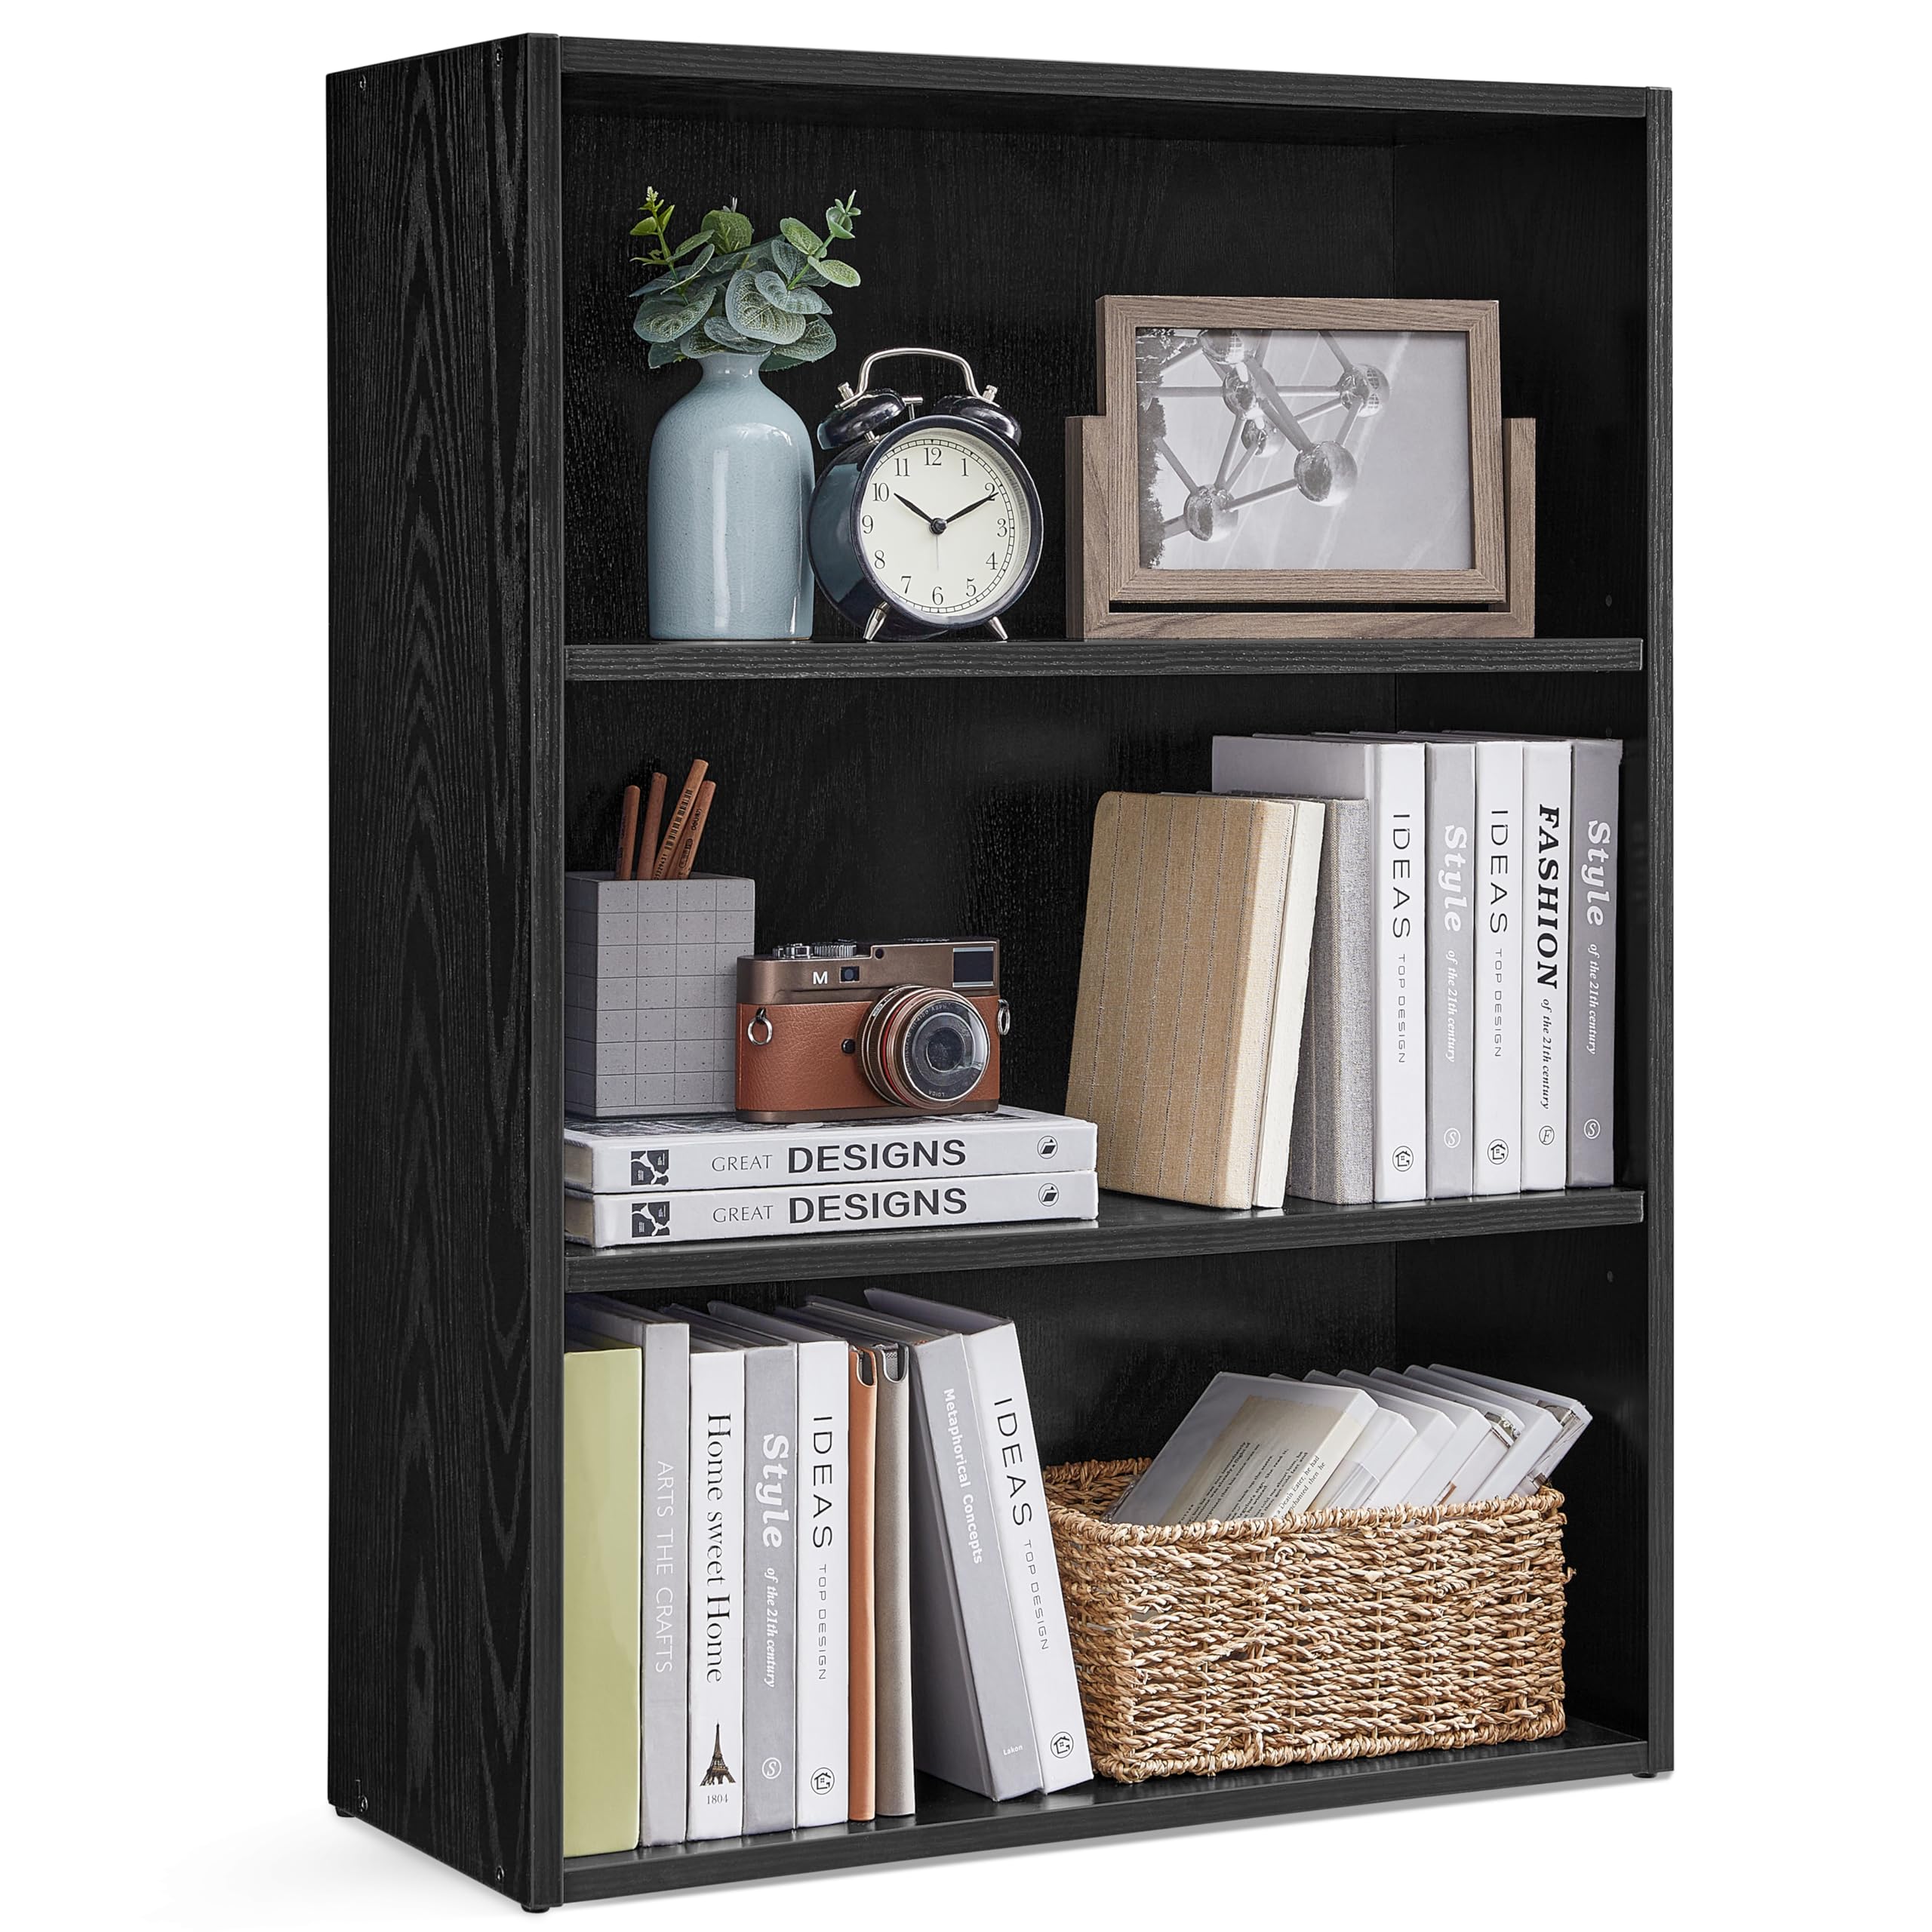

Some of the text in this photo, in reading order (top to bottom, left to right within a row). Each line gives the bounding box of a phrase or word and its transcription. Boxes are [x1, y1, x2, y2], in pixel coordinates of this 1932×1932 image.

[894, 458, 910, 476] 11
[924, 448, 942, 466] 12
[961, 458, 969, 476] 1
[872, 483, 889, 502] 10
[984, 483, 995, 501] 2
[862, 515, 873, 534] 9
[997, 518, 1007, 537] 3
[874, 550, 885, 569] 8
[900, 576, 911, 594] 7
[986, 552, 998, 570] 4
[932, 586, 943, 605] 6
[966, 578, 977, 597] 5
[1393, 814, 1411, 938] IDEAS
[1438, 824, 1468, 932] Style
[1490, 811, 1509, 933] IDEAS
[1537, 804, 1559, 989] FASHION
[1581, 820, 1611, 926] Style
[813, 971, 828, 985] M
[1586, 944, 1600, 1055] of the 21th century
[1445, 949, 1457, 1063] of the 21th century
[1540, 998, 1552, 1109] of the 21th century
[712, 1138, 966, 1174] GREAT DESIGNS
[713, 1188, 968, 1224] GREAT DESIGNS
[813, 1417, 832, 1548] IDEAS
[943, 1388, 983, 1564] Metaphorical Concepts
[994, 1398, 1032, 1526] IDEAS
[1279, 1492, 1294, 1509] Death
[1293, 1477, 1306, 1492] Eater,
[1304, 1467, 1311, 1476] he
[1310, 1456, 1320, 1467] had
[1309, 1472, 1319, 1485] then
[1318, 1462, 1325, 1471] he
[755, 1433, 789, 1548] Style
[655, 1460, 675, 1673] ARTS THE CRAFTS
[706, 1413, 731, 1683] Home sweet Home
[1023, 1540, 1048, 1650] TOP DESIGN
[764, 1567, 778, 1688] of the 21th century
[818, 1609, 826, 1680] DESIGN
[706, 1794, 728, 1805] 1804
